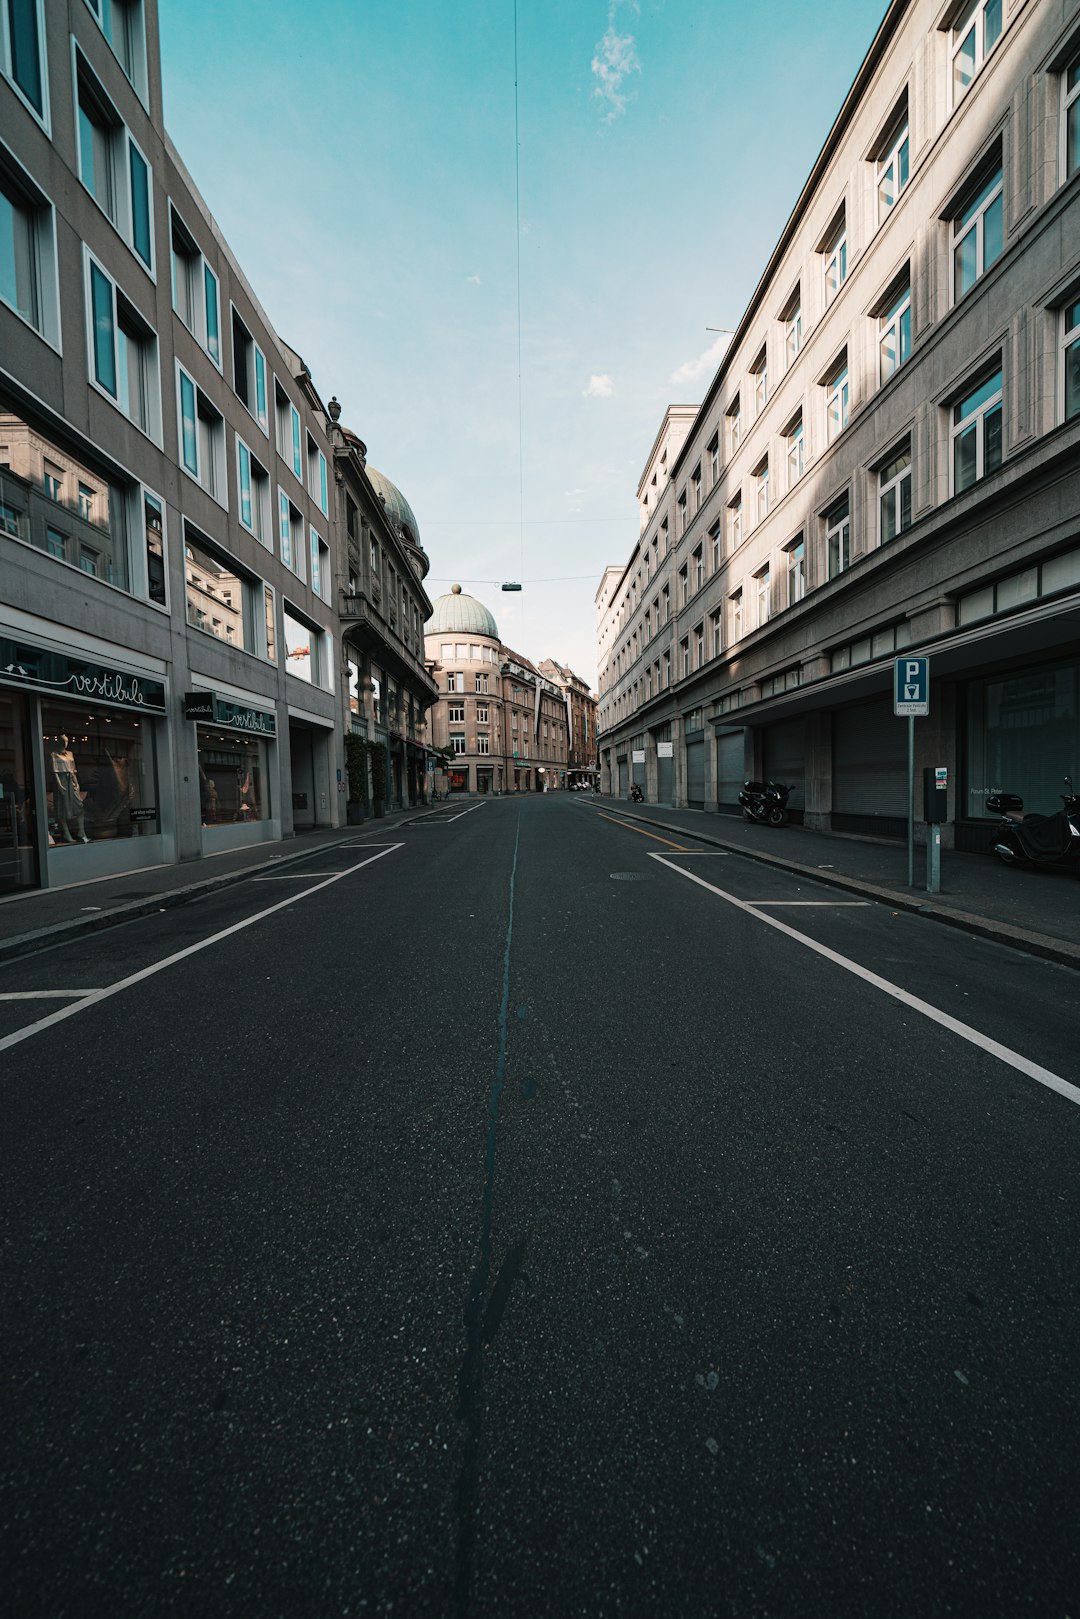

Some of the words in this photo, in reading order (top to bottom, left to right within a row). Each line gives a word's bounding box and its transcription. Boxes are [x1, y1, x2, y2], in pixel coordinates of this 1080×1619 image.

[906, 661, 919, 683] P
[69, 673, 143, 704] vestibule
[232, 712, 266, 731] vestibule
